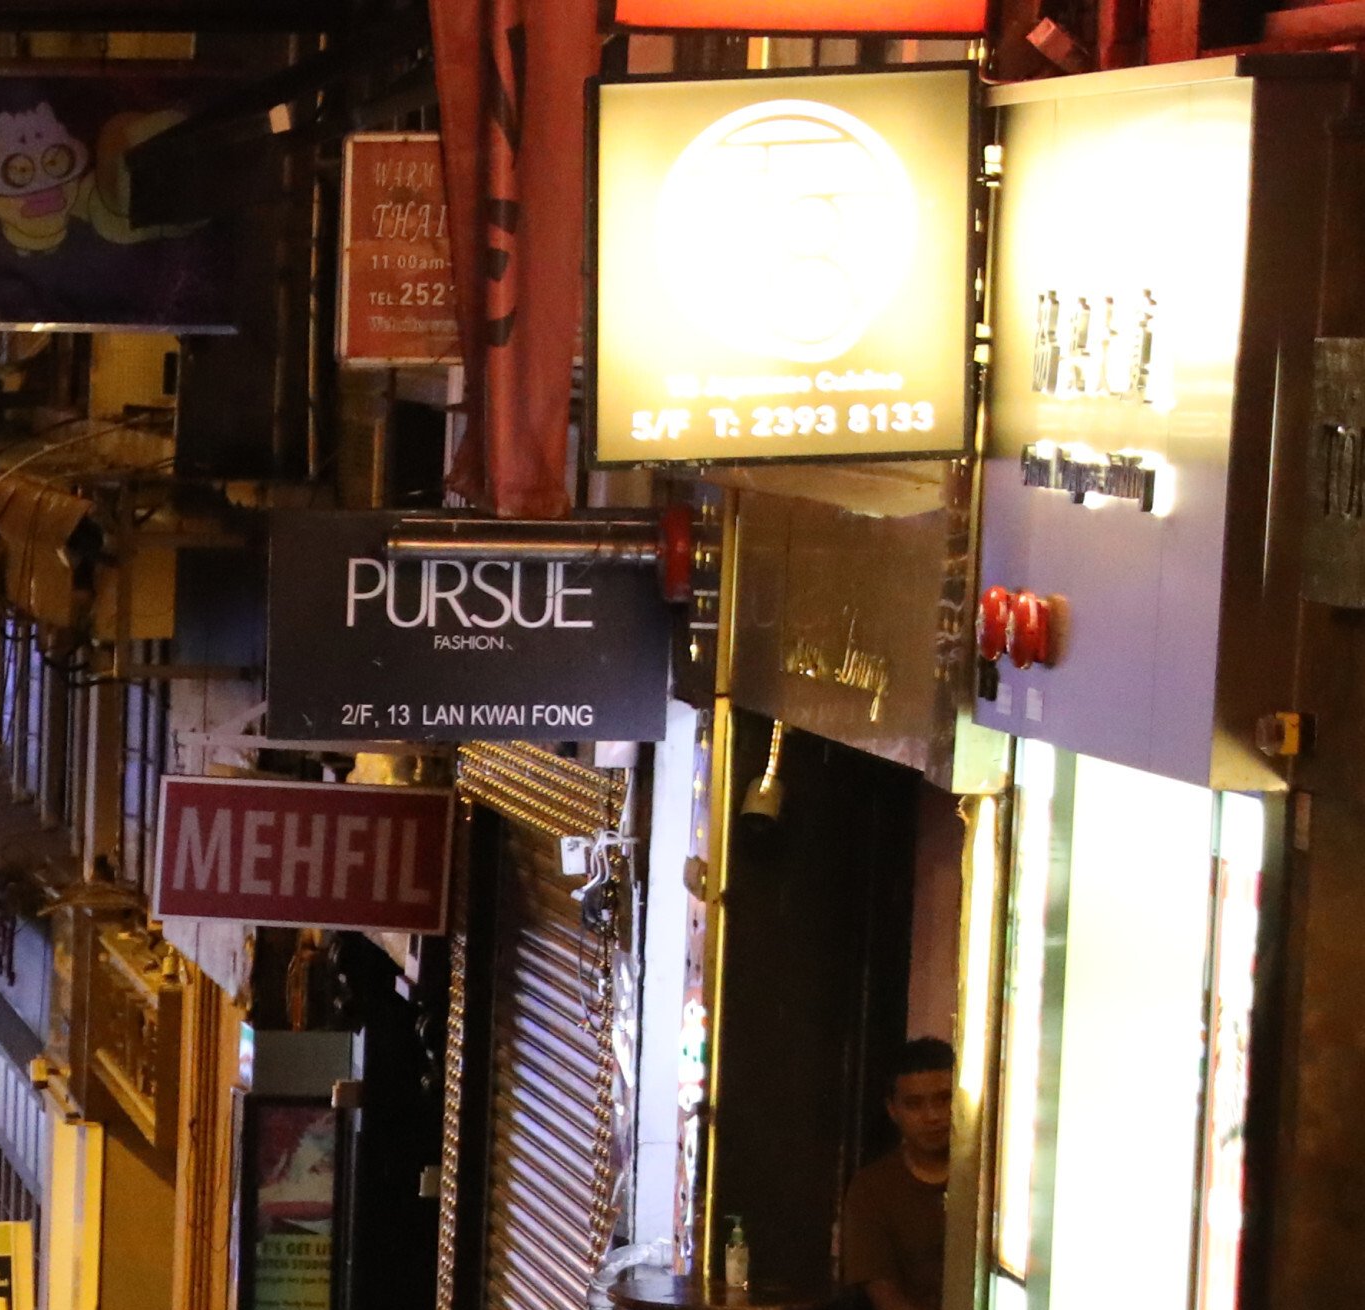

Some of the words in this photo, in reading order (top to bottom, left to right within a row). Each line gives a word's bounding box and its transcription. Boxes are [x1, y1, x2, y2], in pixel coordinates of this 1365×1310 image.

[371, 201, 448, 243] THAI
[750, 405, 837, 437] 2393
[848, 401, 935, 433] 8133
[345, 556, 595, 630] PURSUE
[433, 634, 505, 651] FASHION
[341, 704, 380, 729] 2/F,
[387, 704, 411, 727] 13
[422, 704, 466, 727] LAN
[470, 704, 526, 727] KWAI
[531, 704, 594, 727] FONG
[172, 803, 431, 905] MEHFIL
